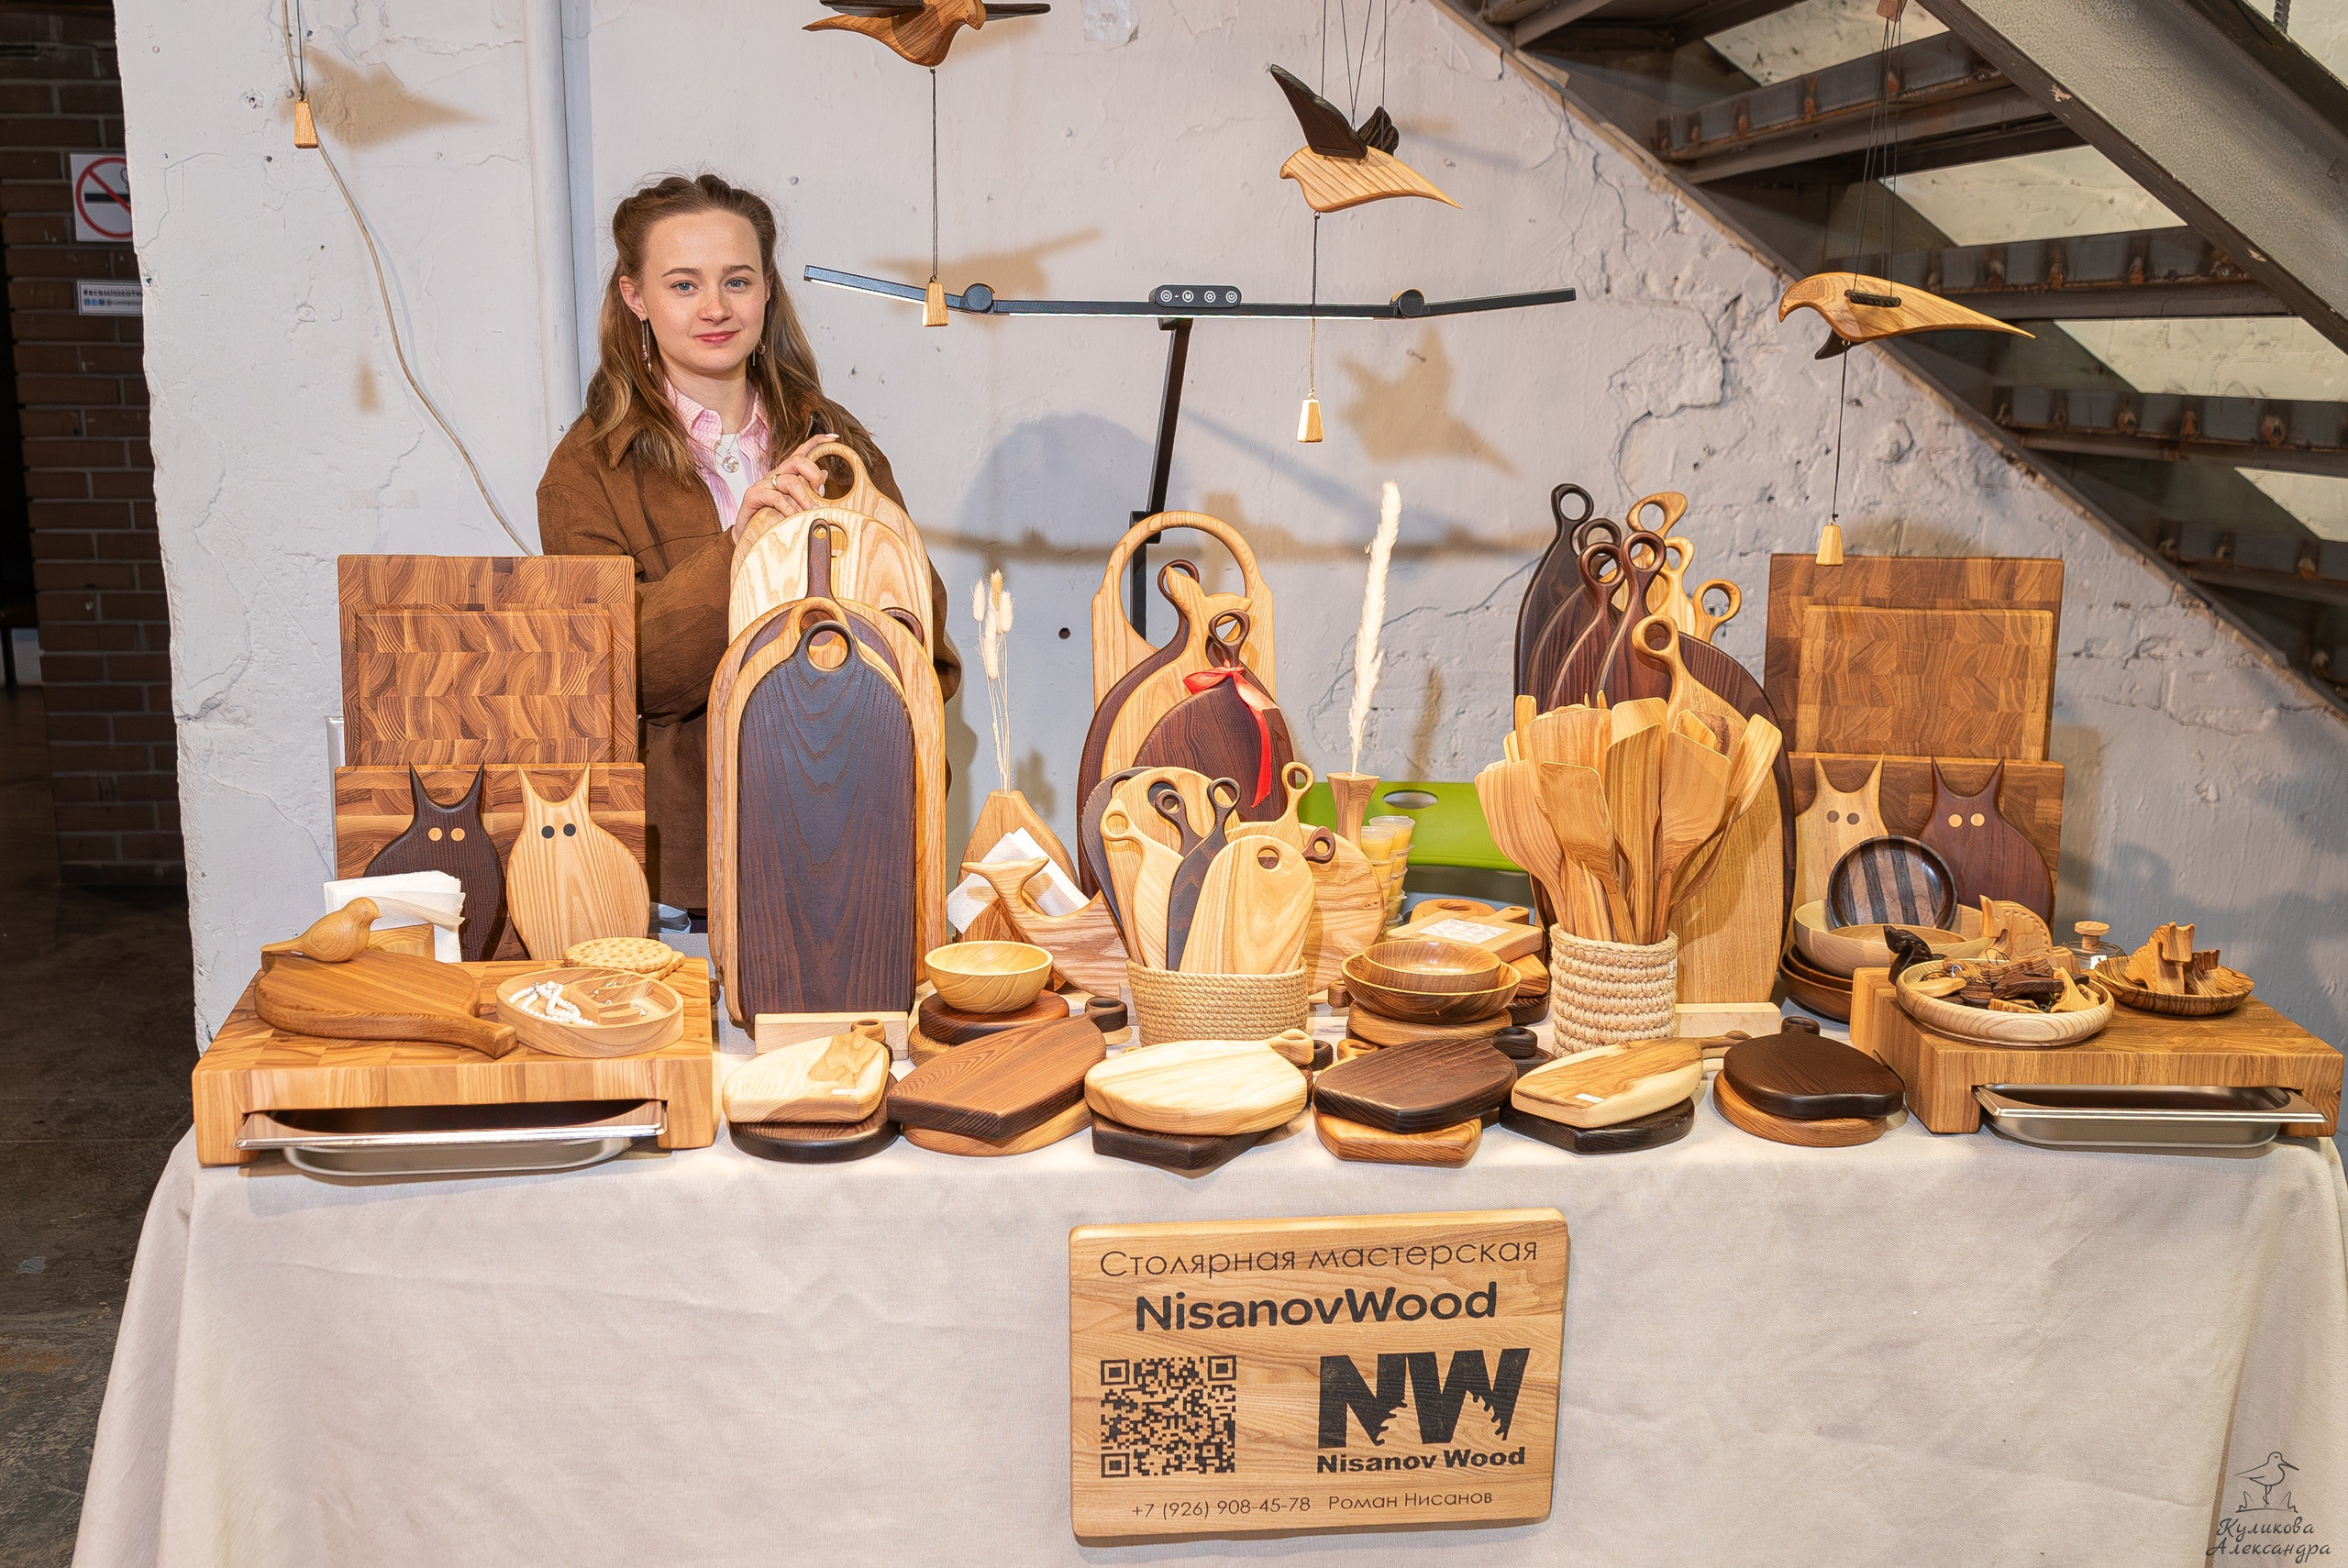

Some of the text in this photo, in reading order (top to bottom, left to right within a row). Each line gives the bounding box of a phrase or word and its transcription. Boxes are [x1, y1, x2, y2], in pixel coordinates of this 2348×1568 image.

[1101, 1242, 1538, 1278] Столярная мастерская
[1135, 1281, 1497, 1331] NisanovWood
[1317, 1348, 1531, 1449] NW
[1316, 1446, 1526, 1474] Nisanov Wood
[1132, 1492, 1493, 1518] +7 (926) 908-45-78 Роман Нисанов
